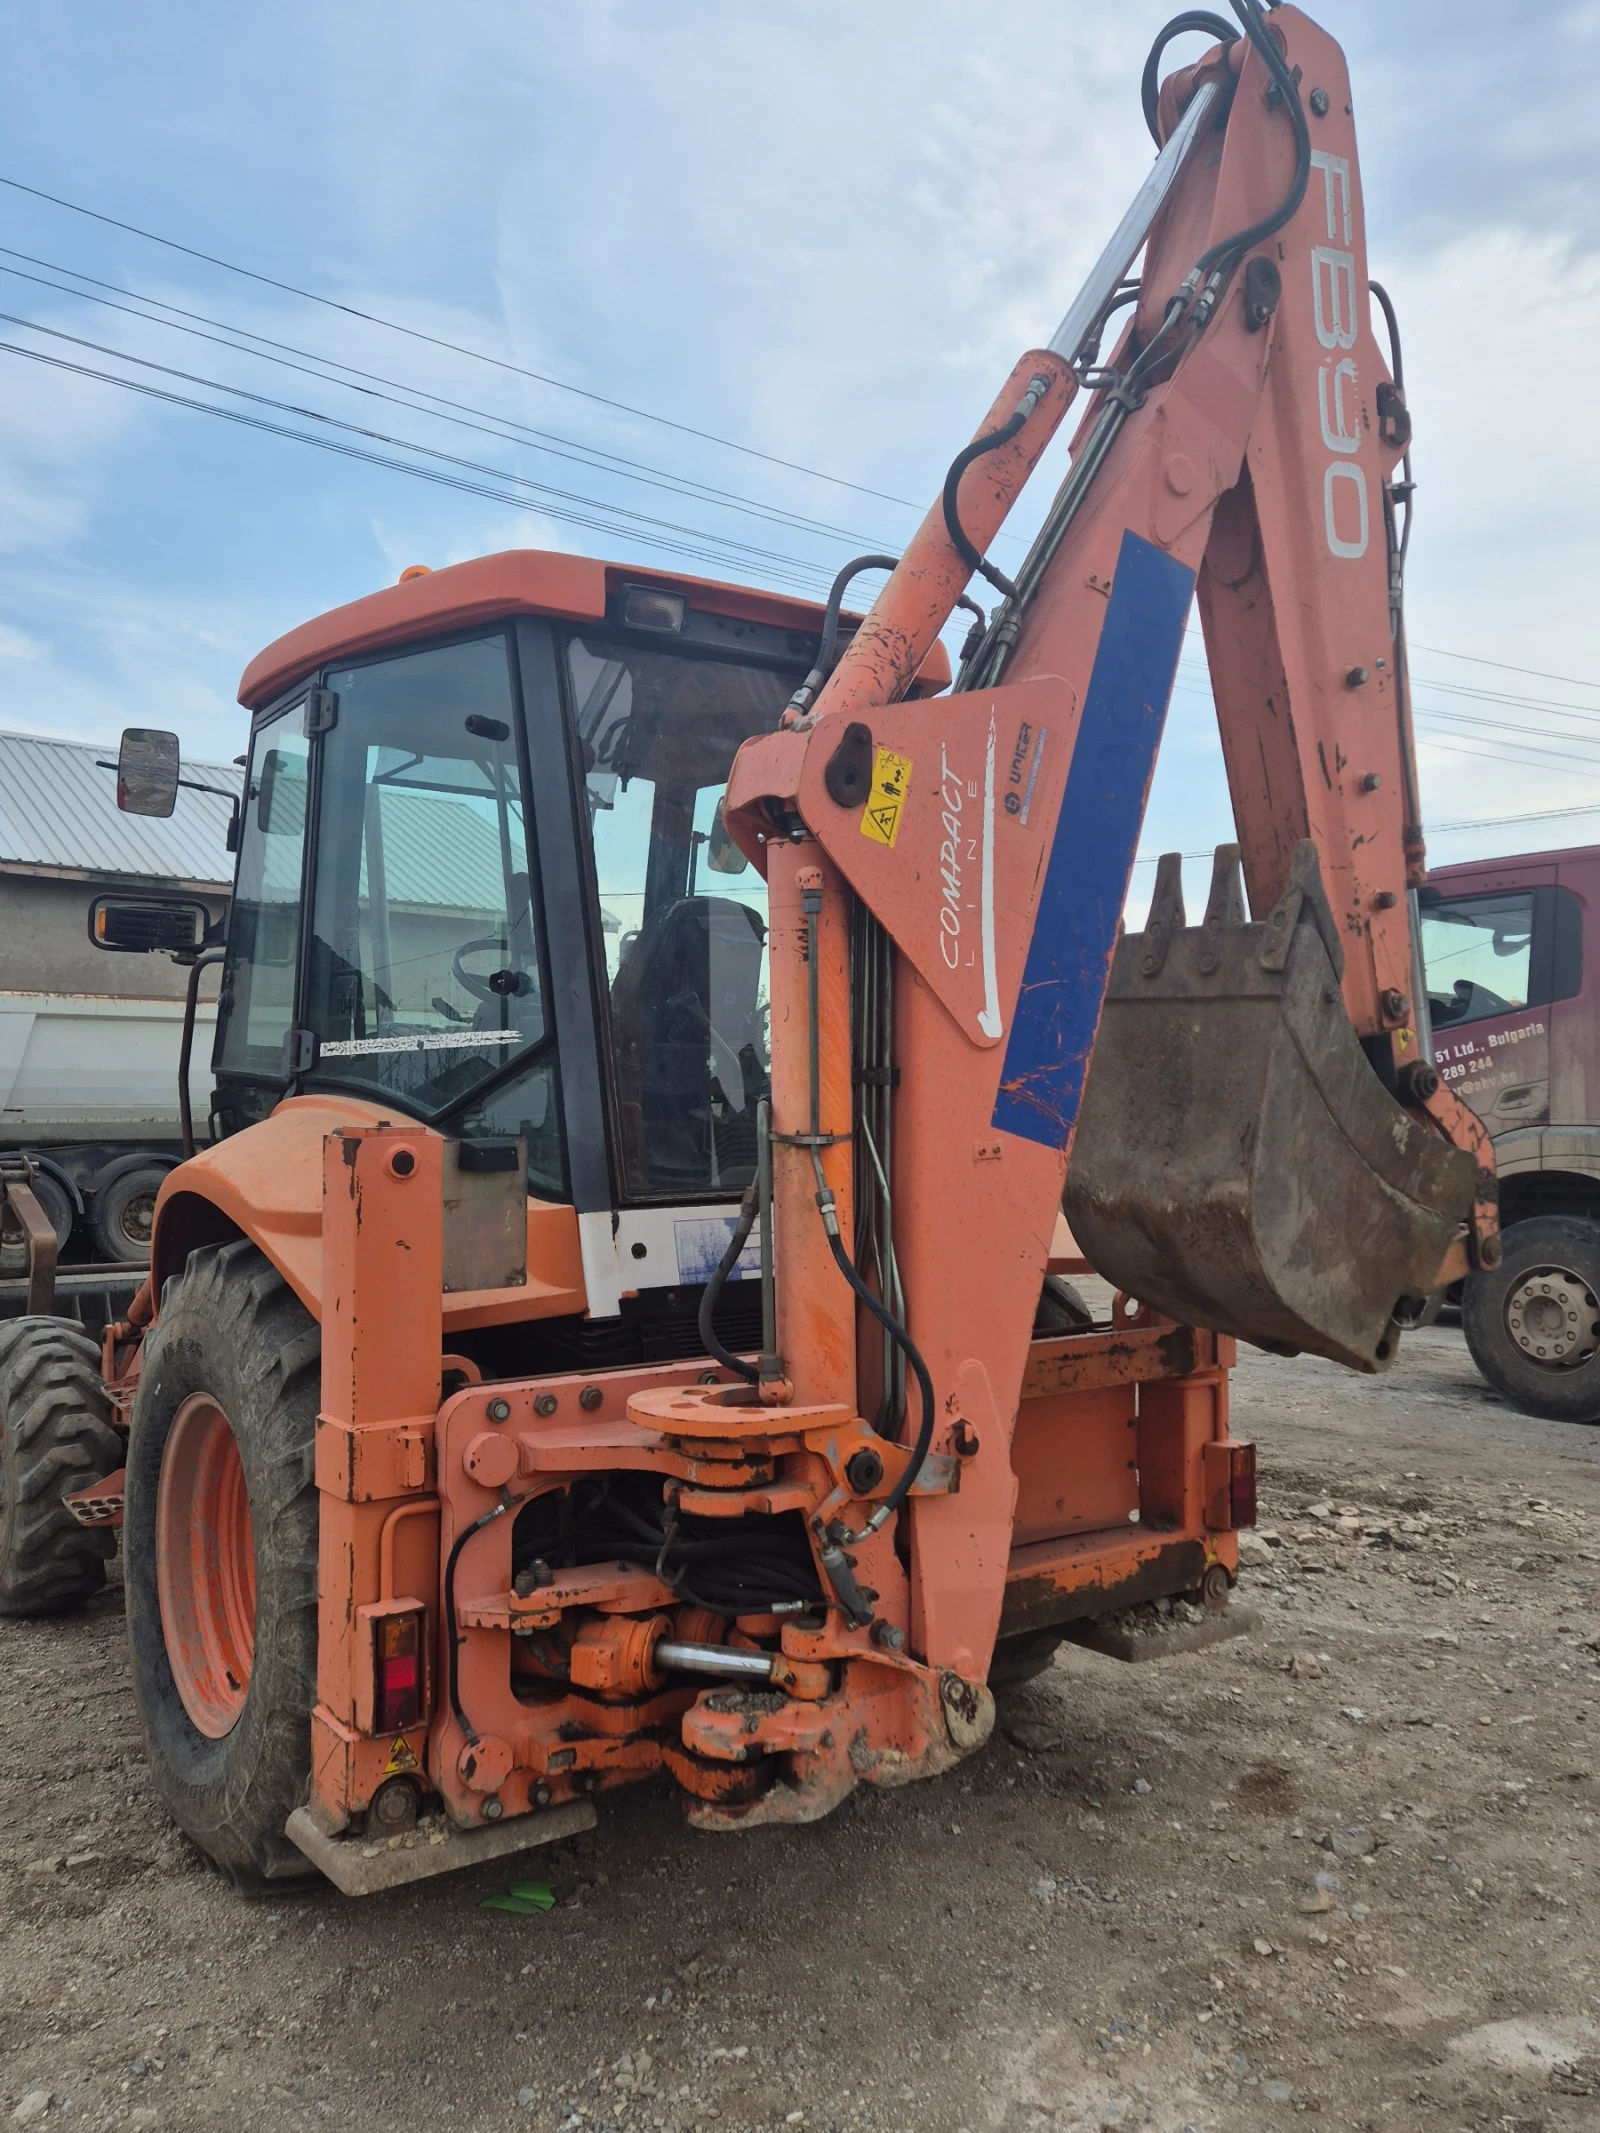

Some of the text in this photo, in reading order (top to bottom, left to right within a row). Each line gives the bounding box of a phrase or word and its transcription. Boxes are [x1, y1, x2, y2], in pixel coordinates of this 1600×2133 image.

[940, 741, 964, 969] COMPACT
[1435, 1048, 1451, 1063] 51
[1487, 1023, 1545, 1047] Bulgaria
[1442, 1056, 1494, 1081] 289 244
